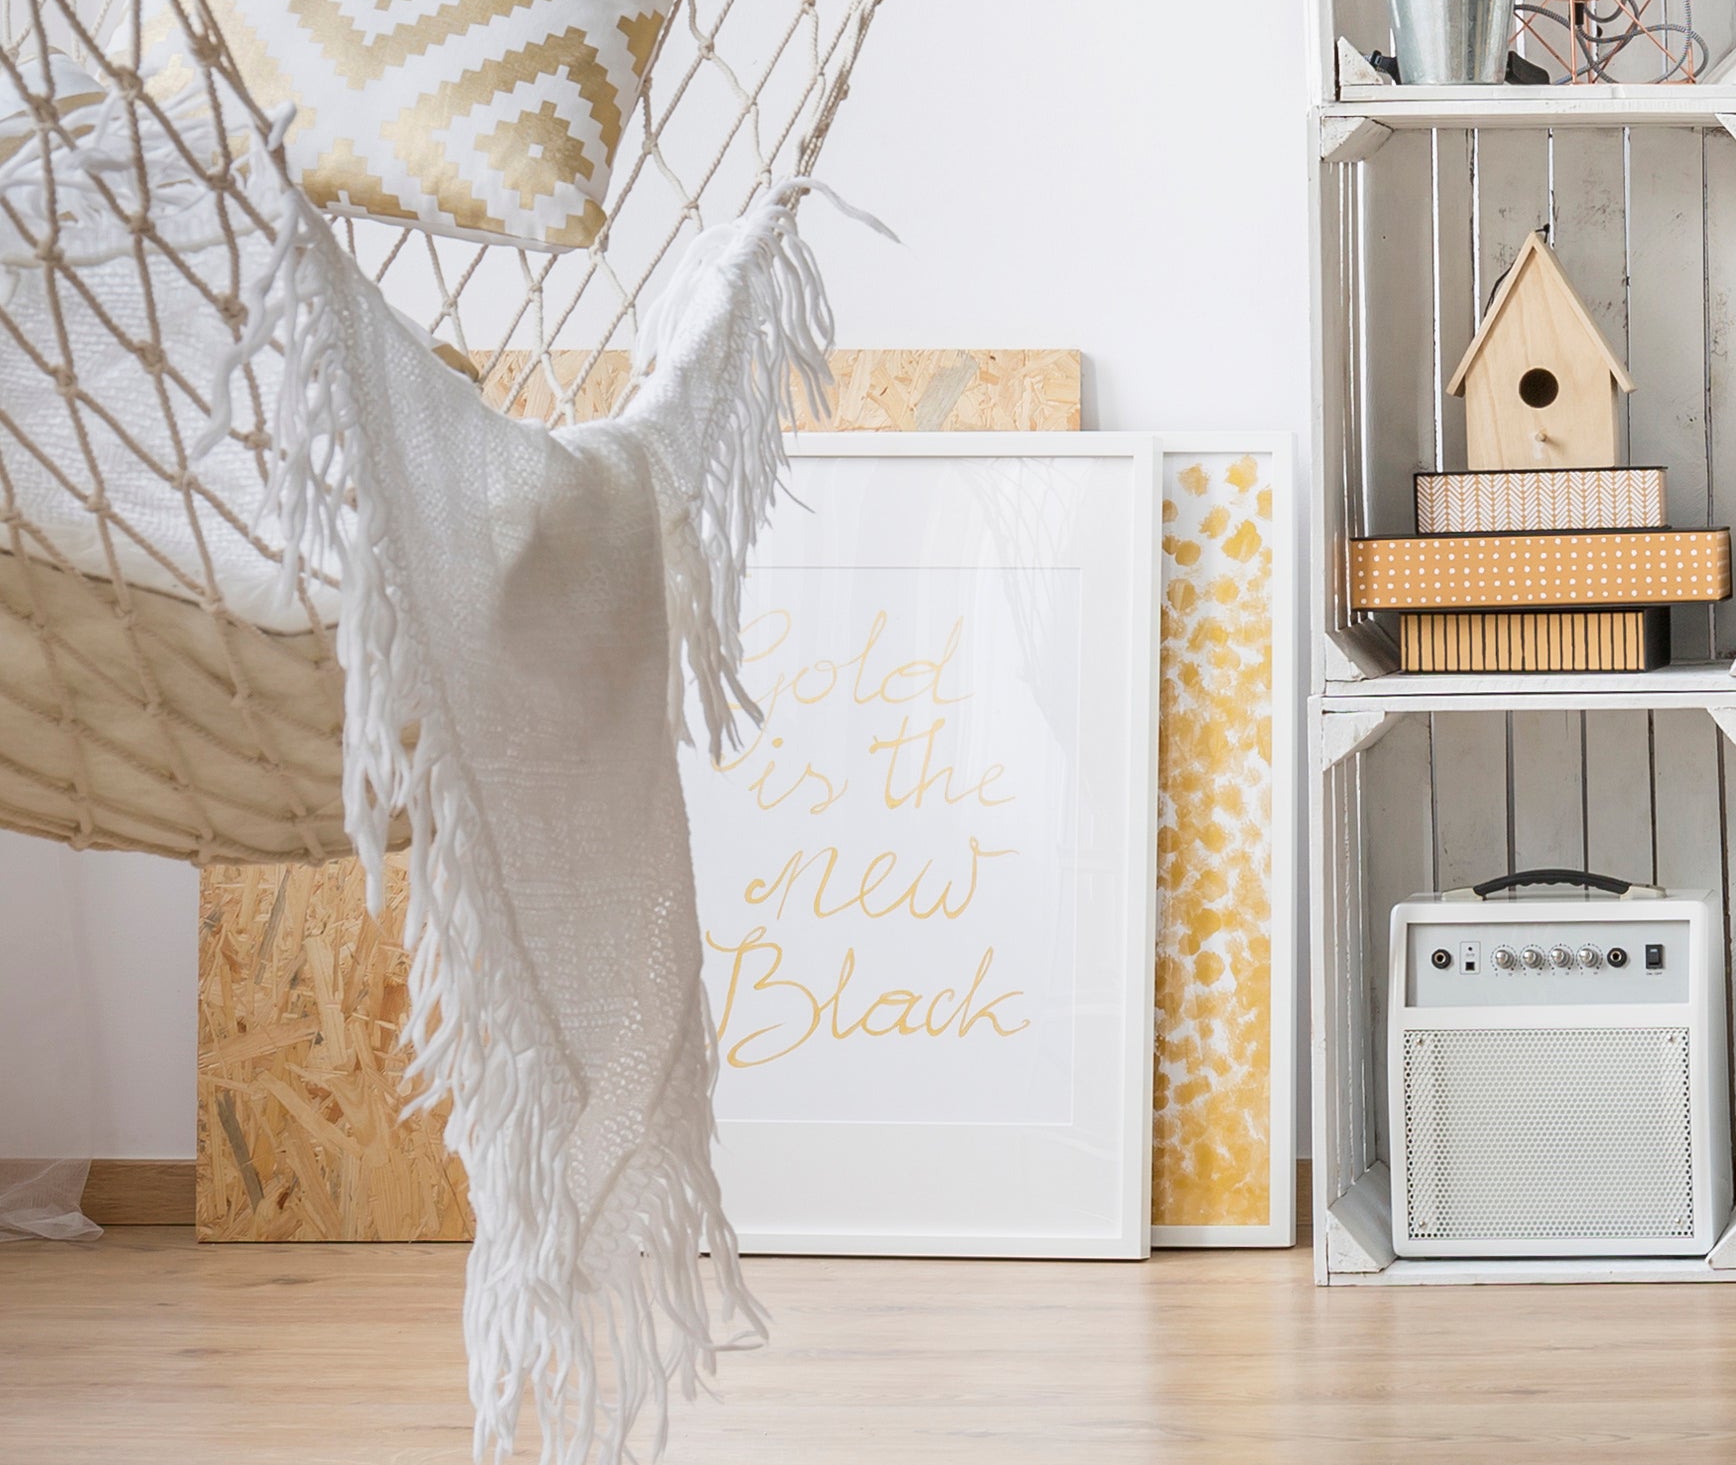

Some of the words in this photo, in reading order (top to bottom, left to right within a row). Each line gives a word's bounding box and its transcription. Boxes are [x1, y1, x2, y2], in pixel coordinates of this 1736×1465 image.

[711, 608, 975, 772] Gold
[747, 737, 849, 816] is
[868, 714, 1016, 810] the
[743, 835, 1020, 921] new
[704, 925, 1031, 1069] Black
